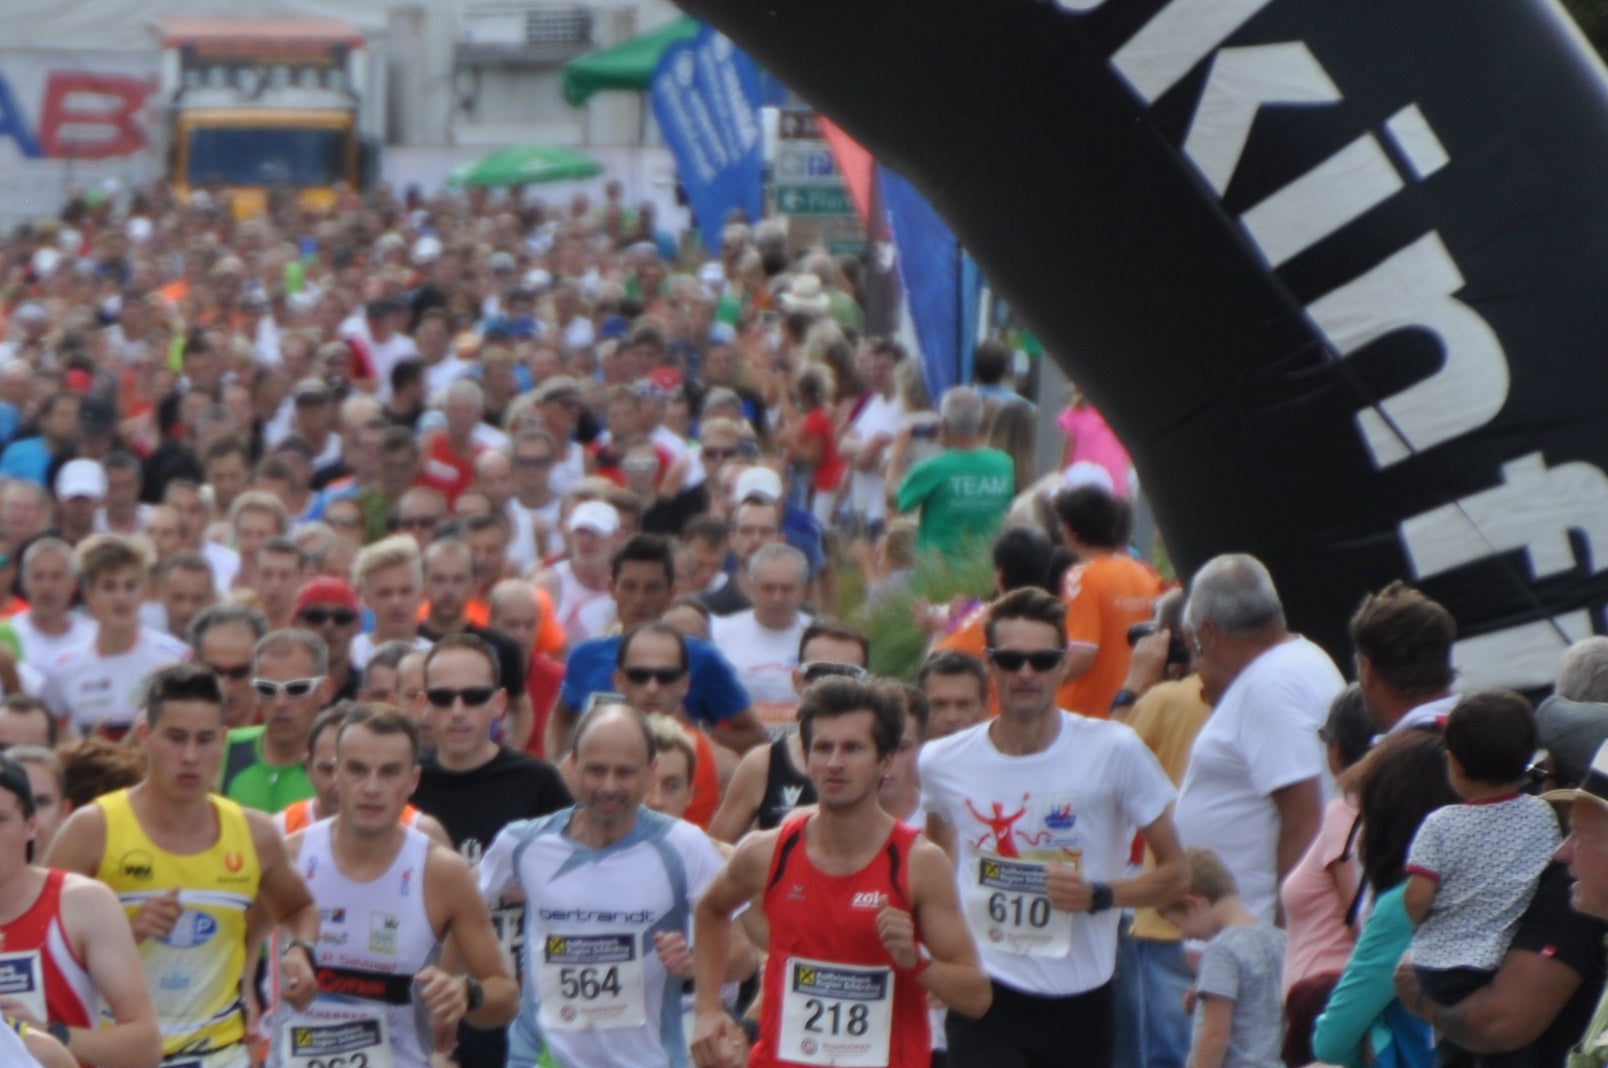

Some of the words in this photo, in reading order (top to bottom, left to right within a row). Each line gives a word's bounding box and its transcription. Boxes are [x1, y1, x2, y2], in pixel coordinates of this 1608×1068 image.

[950, 476, 1009, 496] TEAM
[539, 907, 655, 923] bertrandt
[989, 892, 1051, 929] 610
[560, 966, 622, 999] 564
[805, 999, 870, 1037] 218
